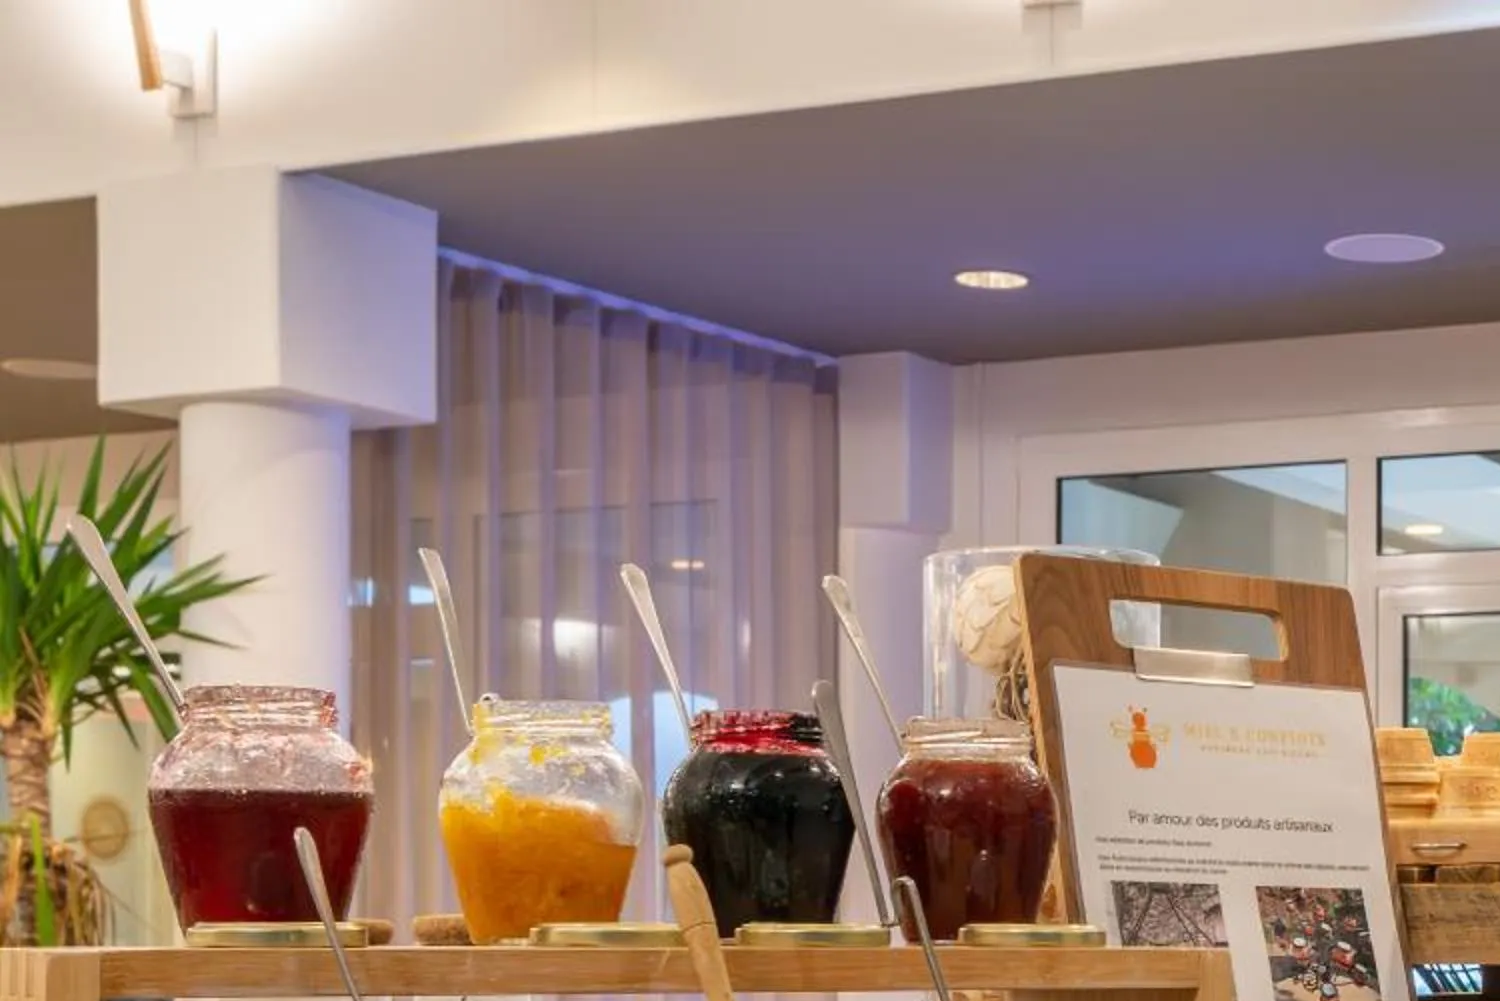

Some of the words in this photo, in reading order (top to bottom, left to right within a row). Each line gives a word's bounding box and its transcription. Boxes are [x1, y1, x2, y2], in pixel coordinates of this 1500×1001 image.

[1128, 809, 1149, 825] Par
[1154, 812, 1191, 826] amour
[1196, 813, 1219, 828] des
[1221, 815, 1271, 831] produits
